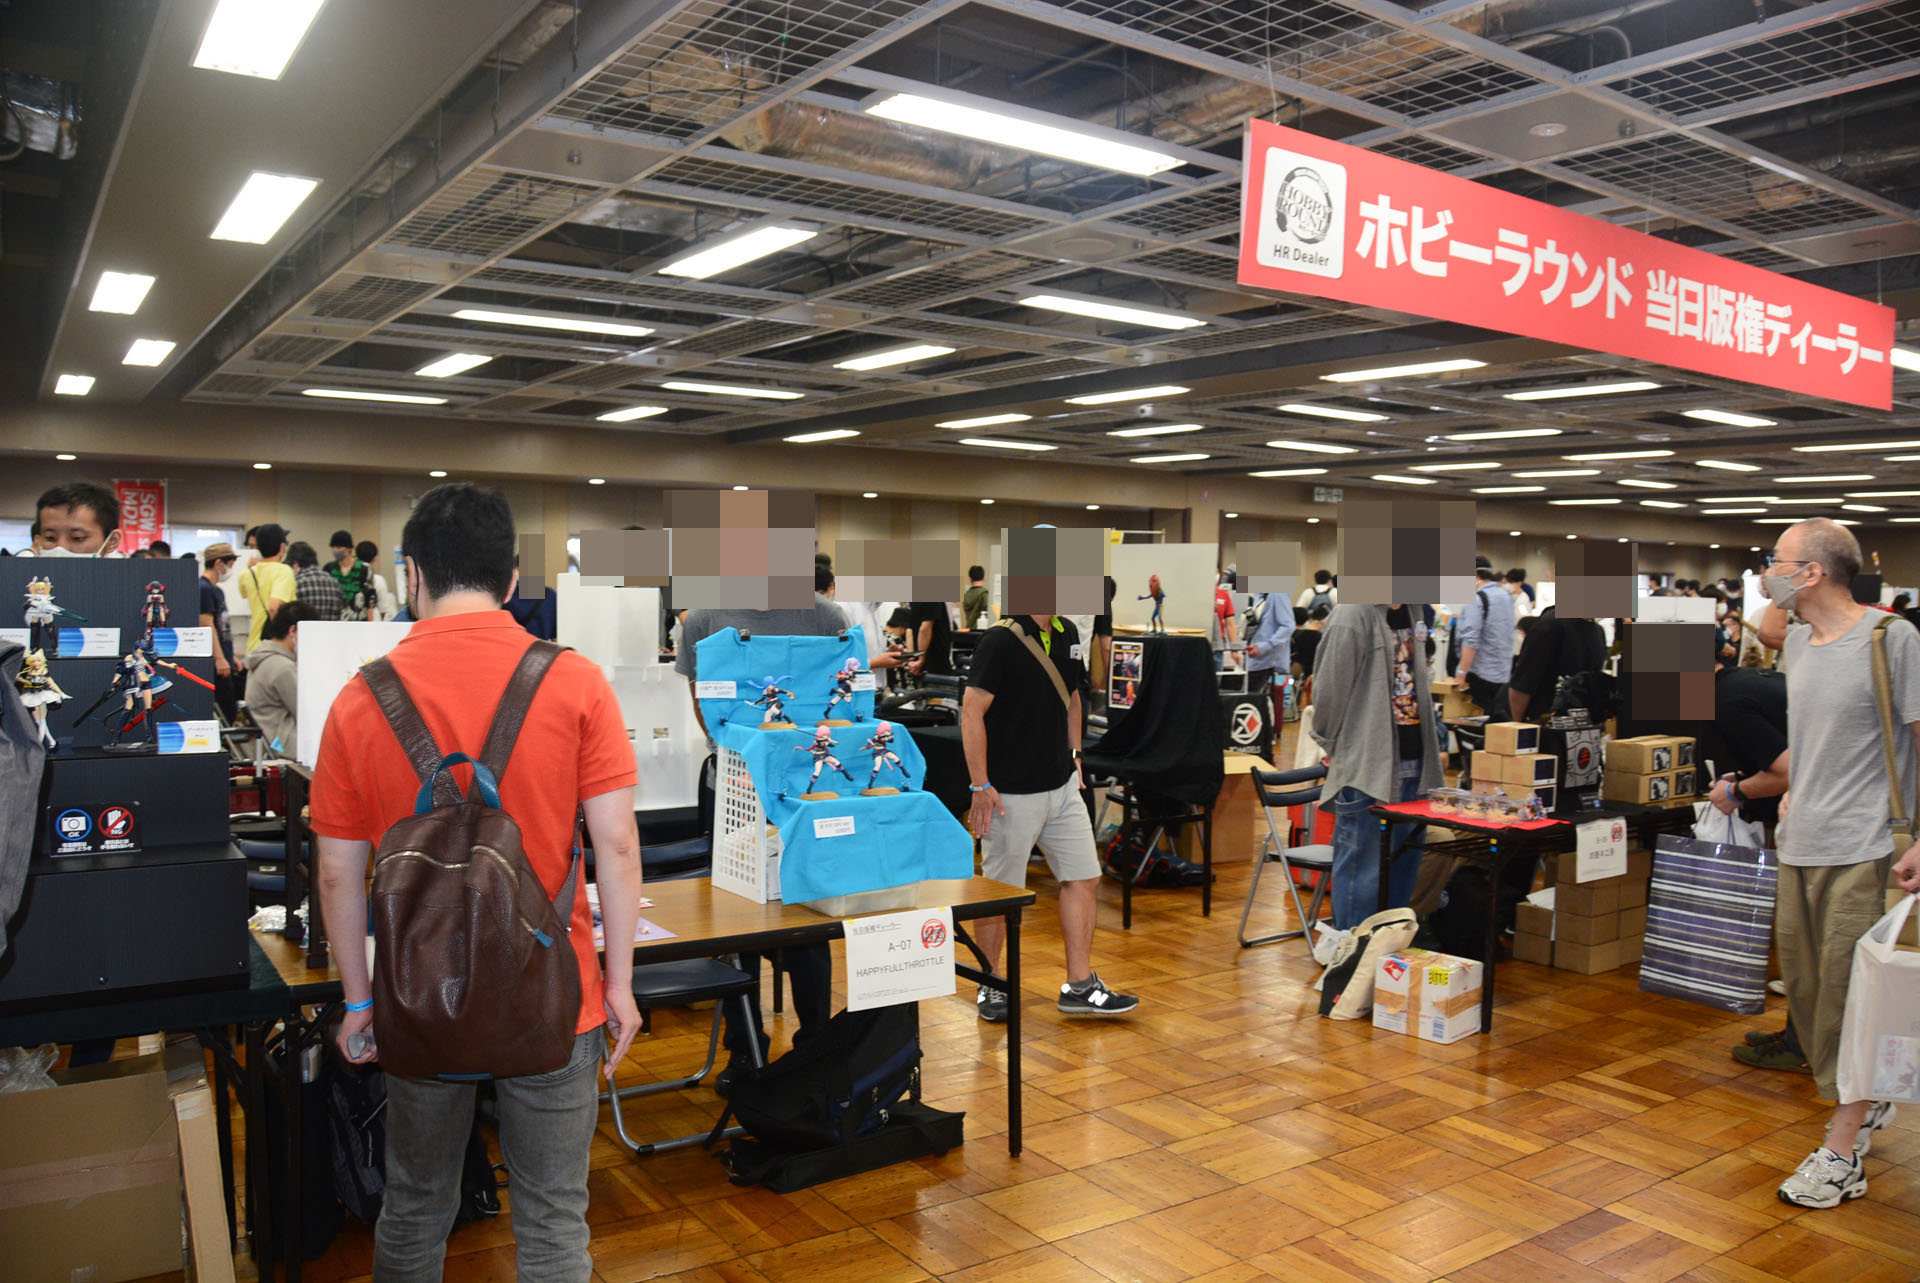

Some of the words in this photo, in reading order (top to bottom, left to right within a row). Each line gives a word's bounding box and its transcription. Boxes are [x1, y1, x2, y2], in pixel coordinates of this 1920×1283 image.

[1273, 244, 1290, 259] HR
[1293, 248, 1330, 266] Dealer
[1355, 194, 1634, 319] ホビーラウンド
[1646, 270, 1884, 375] 当日版権ディーラー
[888, 939, 912, 952] A-07
[856, 955, 945, 977] HAPPYFULLTHROTTLE
